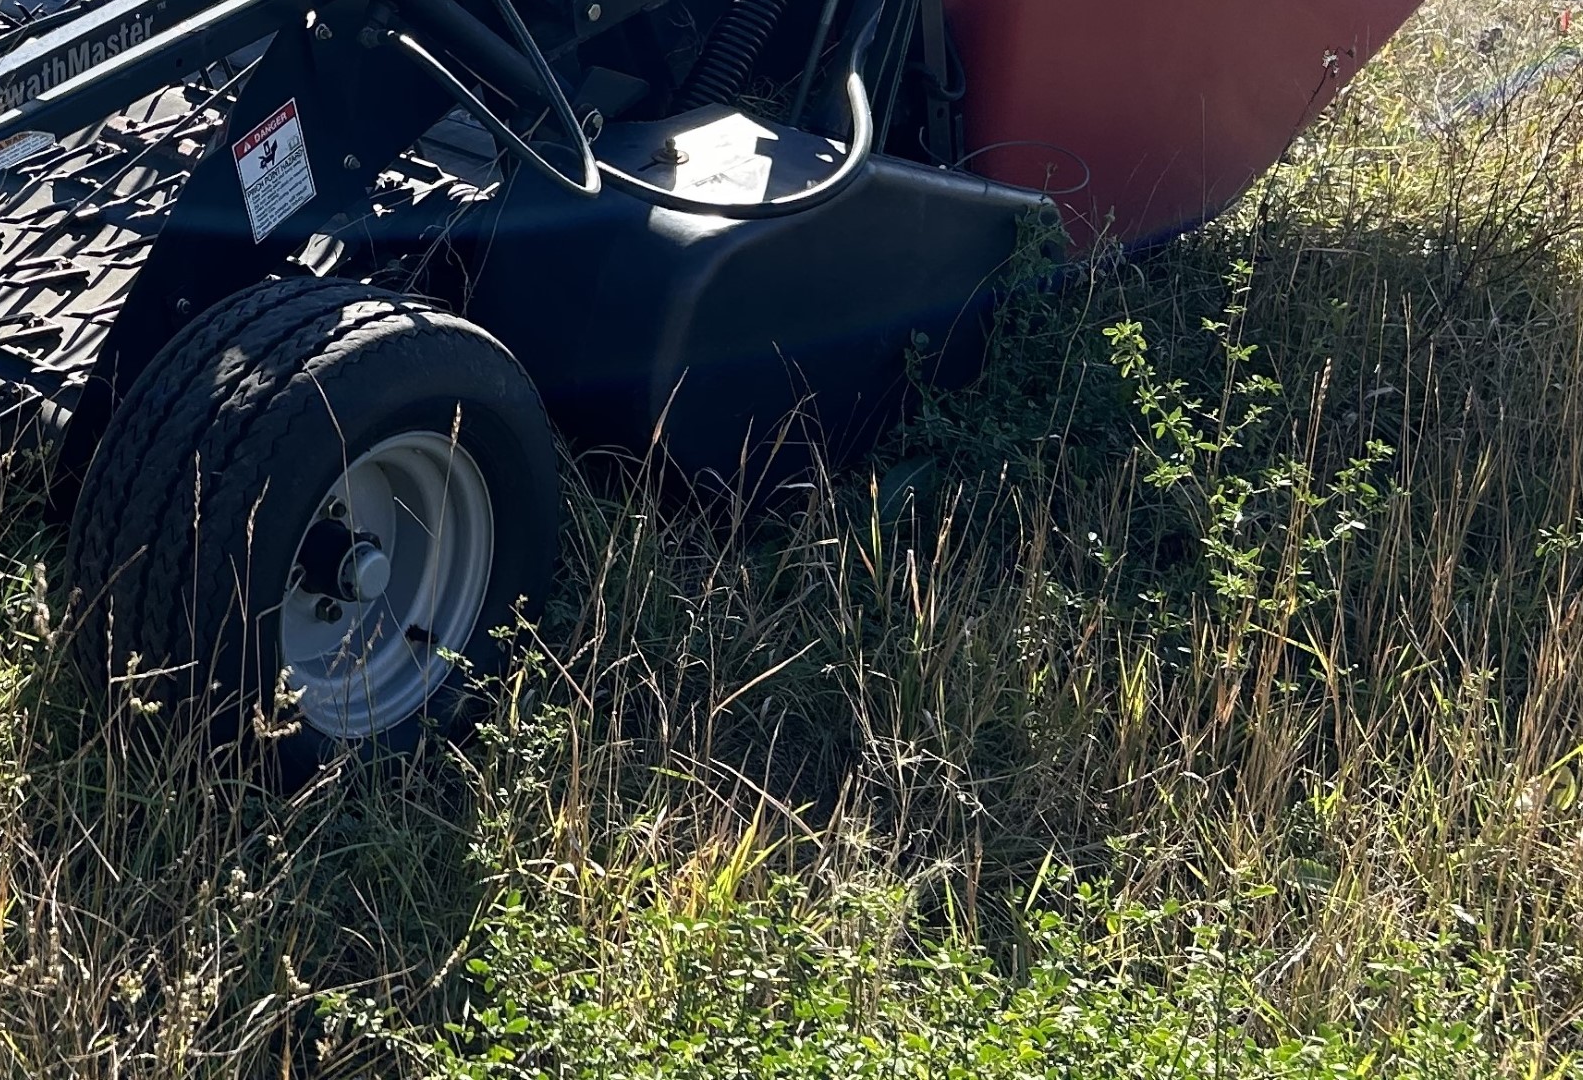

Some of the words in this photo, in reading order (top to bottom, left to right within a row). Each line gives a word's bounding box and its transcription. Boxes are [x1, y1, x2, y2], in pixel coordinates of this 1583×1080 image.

[254, 110, 288, 144] DANGER
[264, 167, 281, 186] POINT
[280, 148, 304, 174] HAZARD
